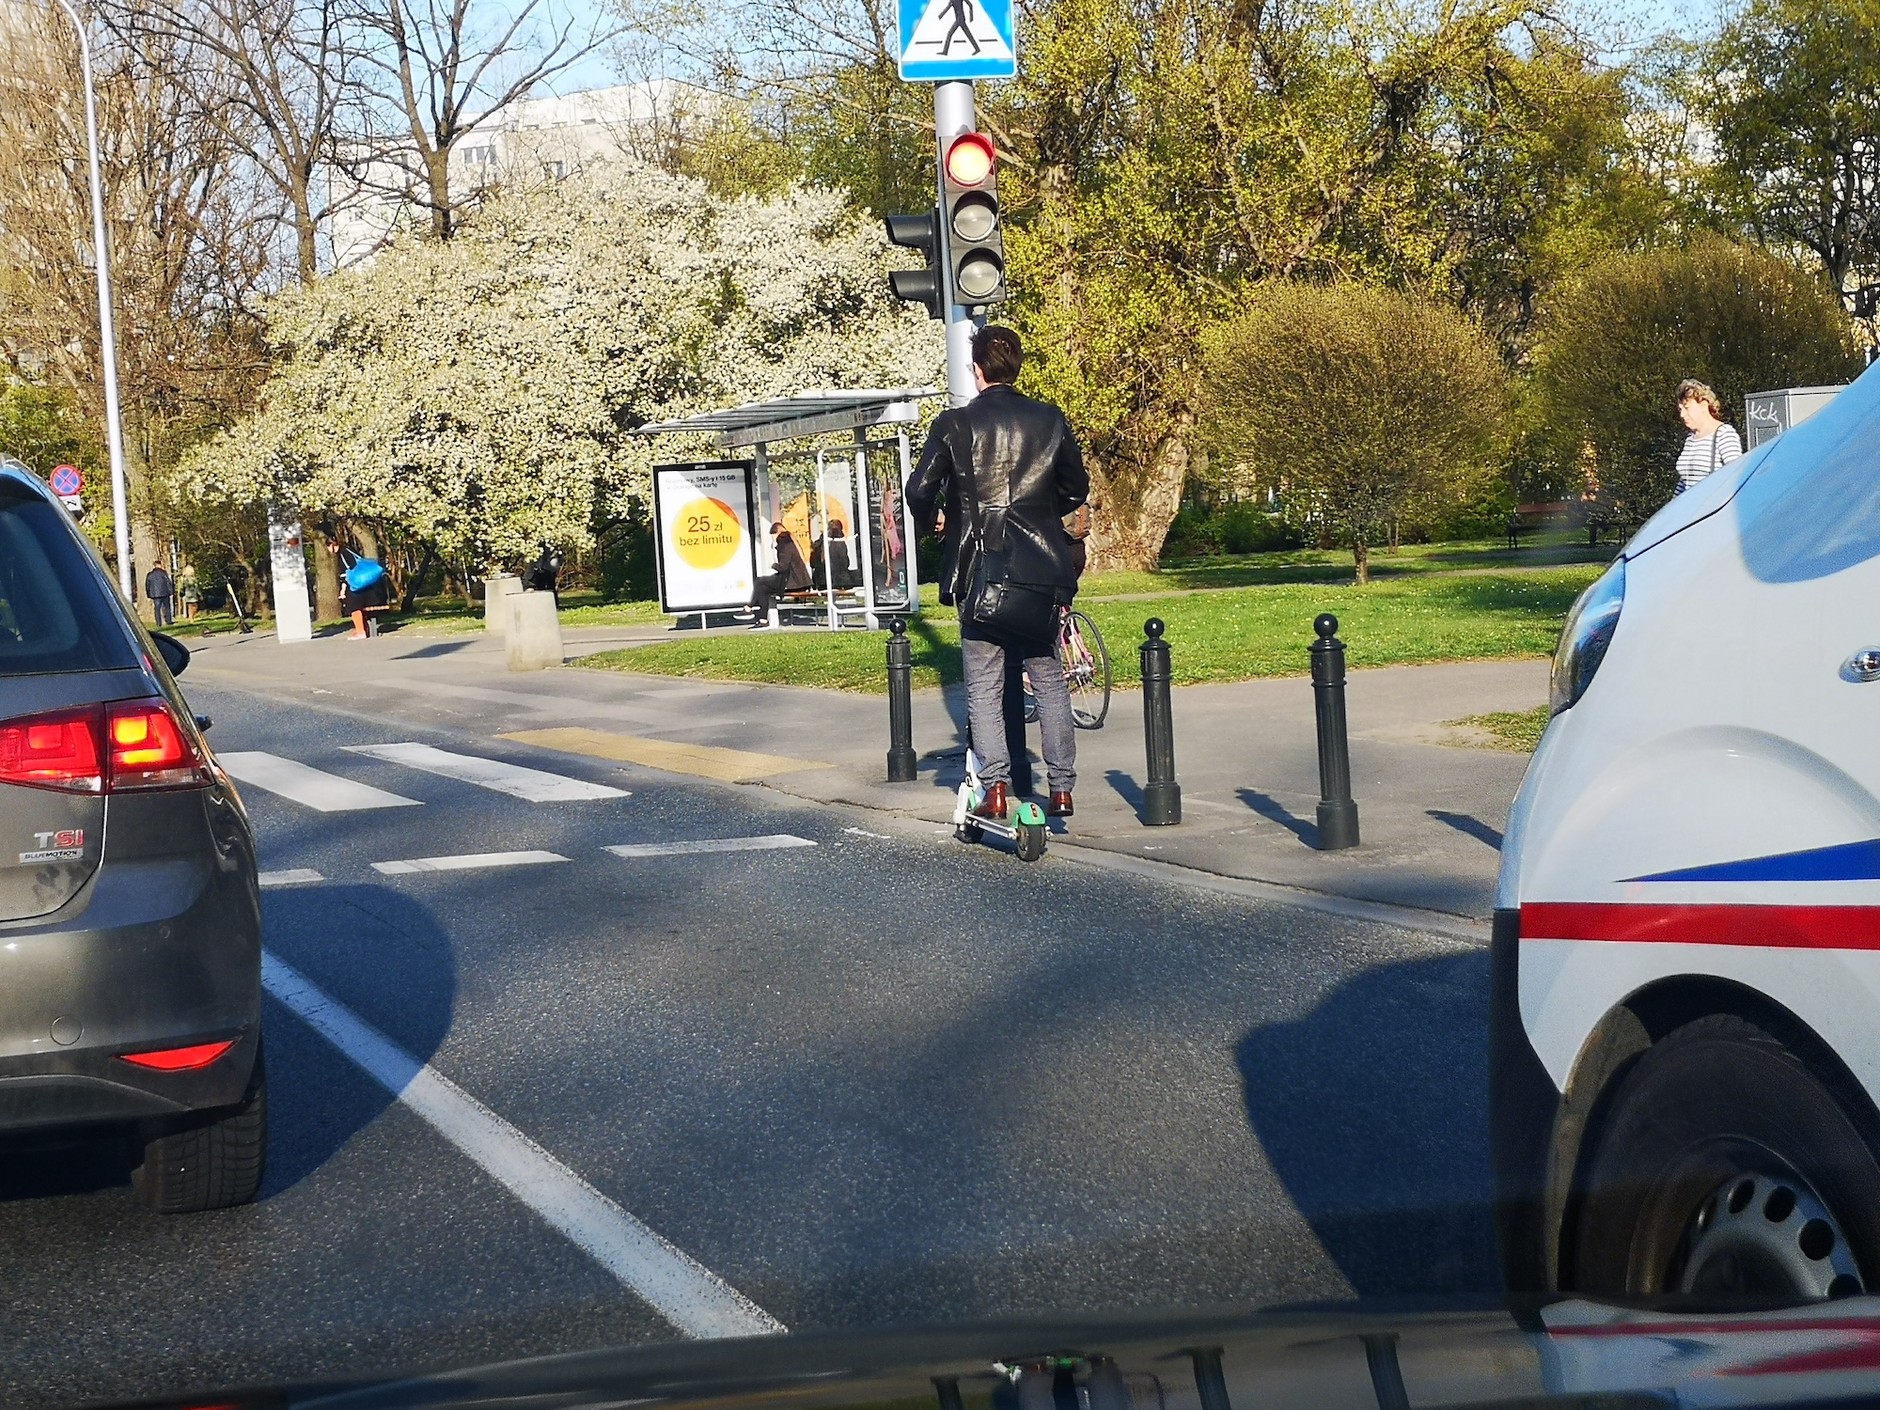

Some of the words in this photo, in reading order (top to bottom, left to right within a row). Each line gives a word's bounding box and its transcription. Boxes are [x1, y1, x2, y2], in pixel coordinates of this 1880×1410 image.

[687, 515, 710, 533] 25
[714, 522, 723, 531] zł
[679, 536, 700, 546] bez
[702, 535, 733, 545] limitu
[34, 829, 84, 849] TSI
[25, 850, 77, 859] BLUEMOTION
